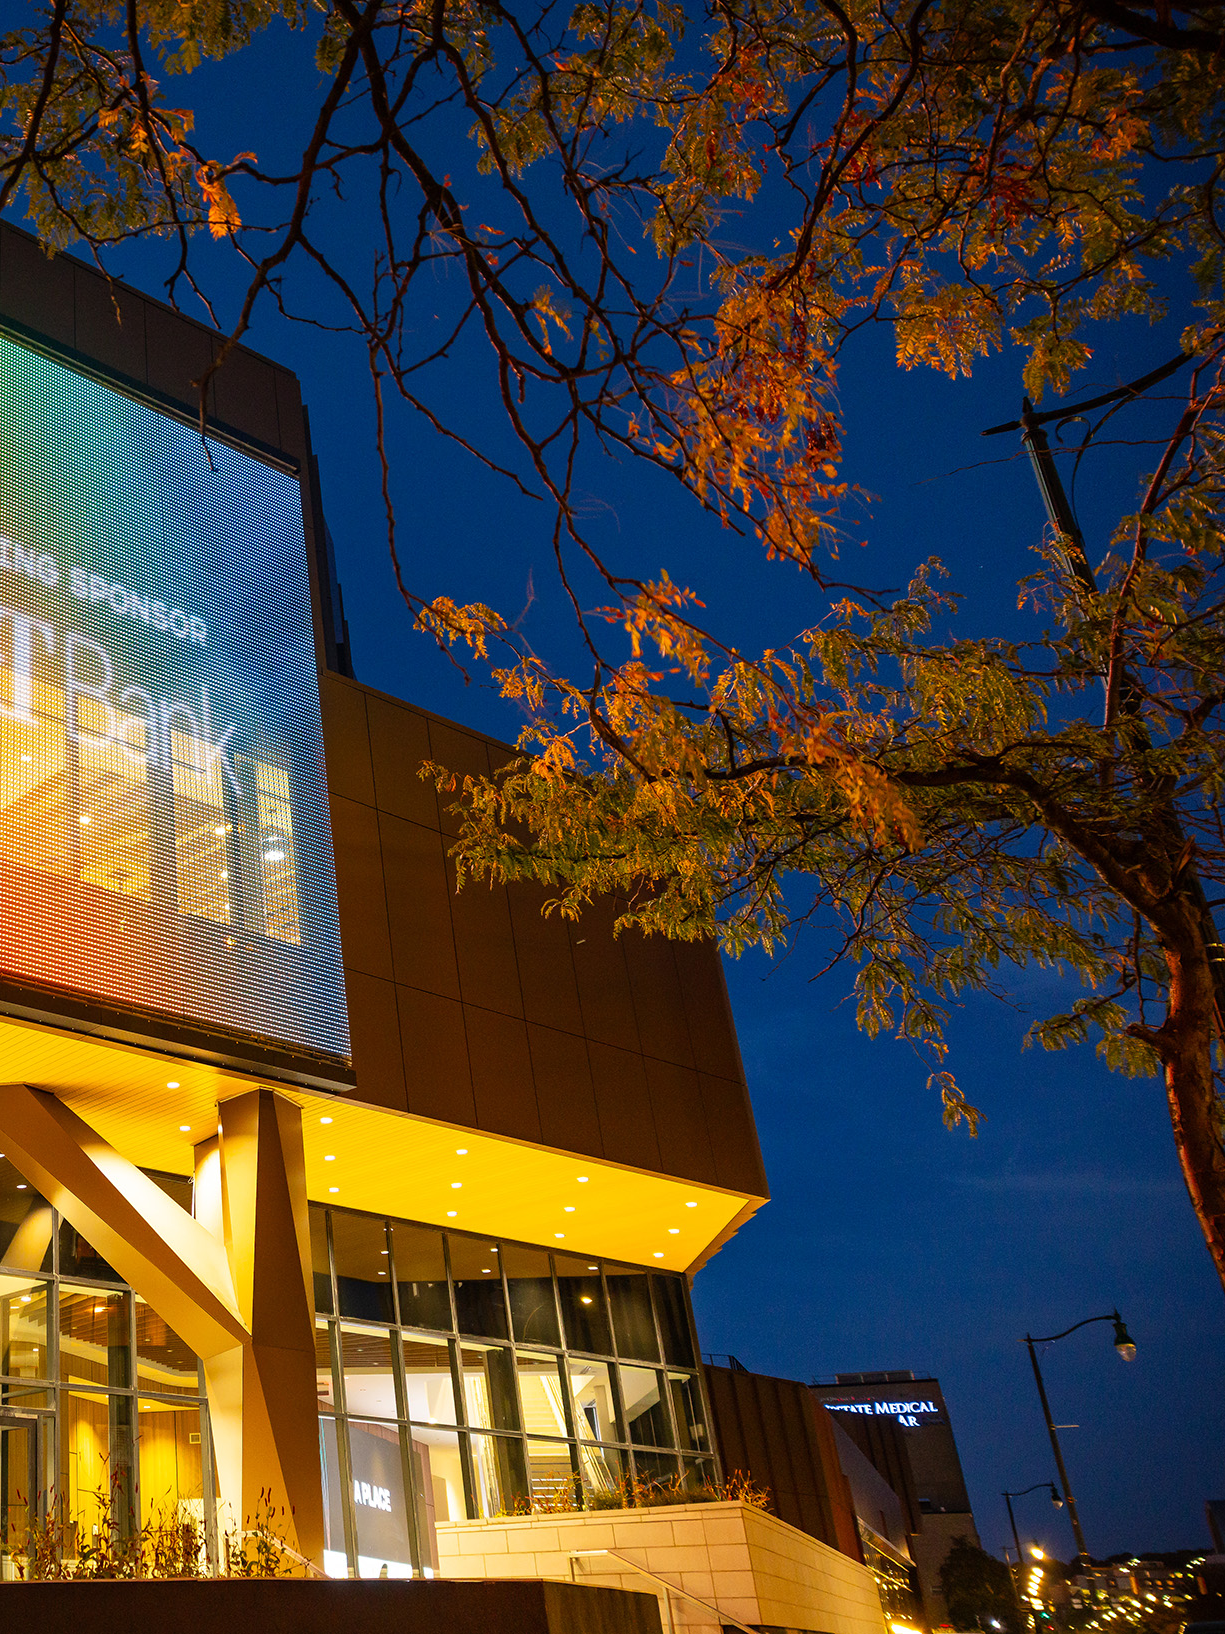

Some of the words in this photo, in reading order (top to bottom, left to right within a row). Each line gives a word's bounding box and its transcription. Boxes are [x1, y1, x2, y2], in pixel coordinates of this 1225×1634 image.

[68, 565, 208, 645] SPONSOR
[65, 630, 246, 798] Bank
[875, 1401, 938, 1415] MEDICAL
[361, 1481, 392, 1512] PLACE
